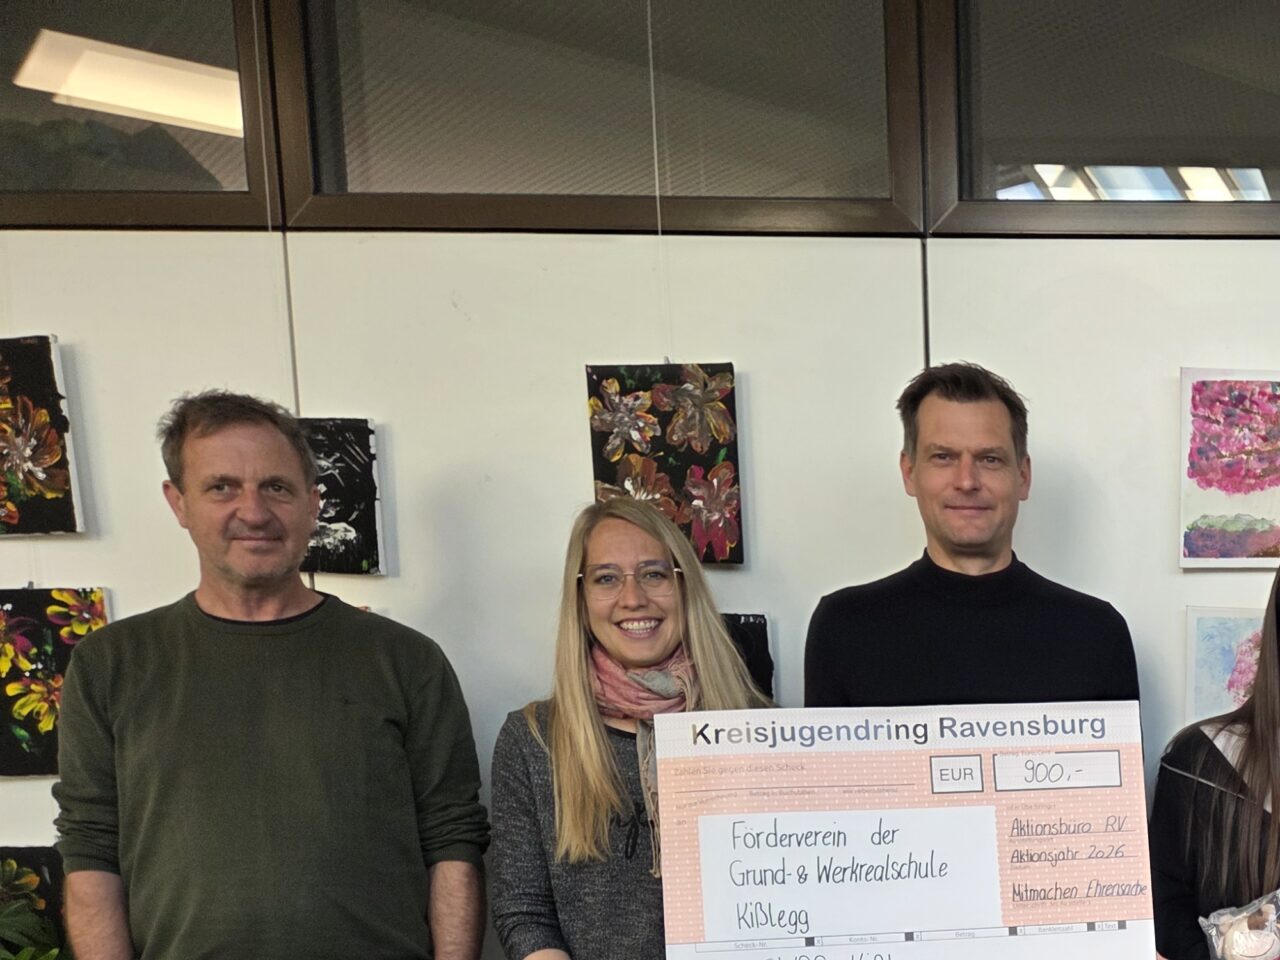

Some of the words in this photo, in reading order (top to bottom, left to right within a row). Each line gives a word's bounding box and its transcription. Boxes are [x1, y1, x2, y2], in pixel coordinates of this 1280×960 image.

[692, 718, 929, 748] Kreisjugendring
[939, 714, 1106, 739] Ravensburg
[939, 767, 975, 782] EUR
[1024, 759, 1084, 783] 900,-
[732, 817, 847, 850] Förderverein
[870, 818, 901, 846] der
[1010, 817, 1092, 837] Aktionsbüro
[1104, 815, 1128, 833] RV
[1010, 846, 1080, 867] Aktionsjahr
[1087, 843, 1126, 859] 2026
[729, 857, 792, 887] Grund-
[796, 864, 808, 884] &
[817, 850, 948, 884] Werkrealschule
[1012, 881, 1078, 902] Mitmachen
[1085, 879, 1148, 898] Ehrensache
[736, 901, 809, 935] Kißlegg
